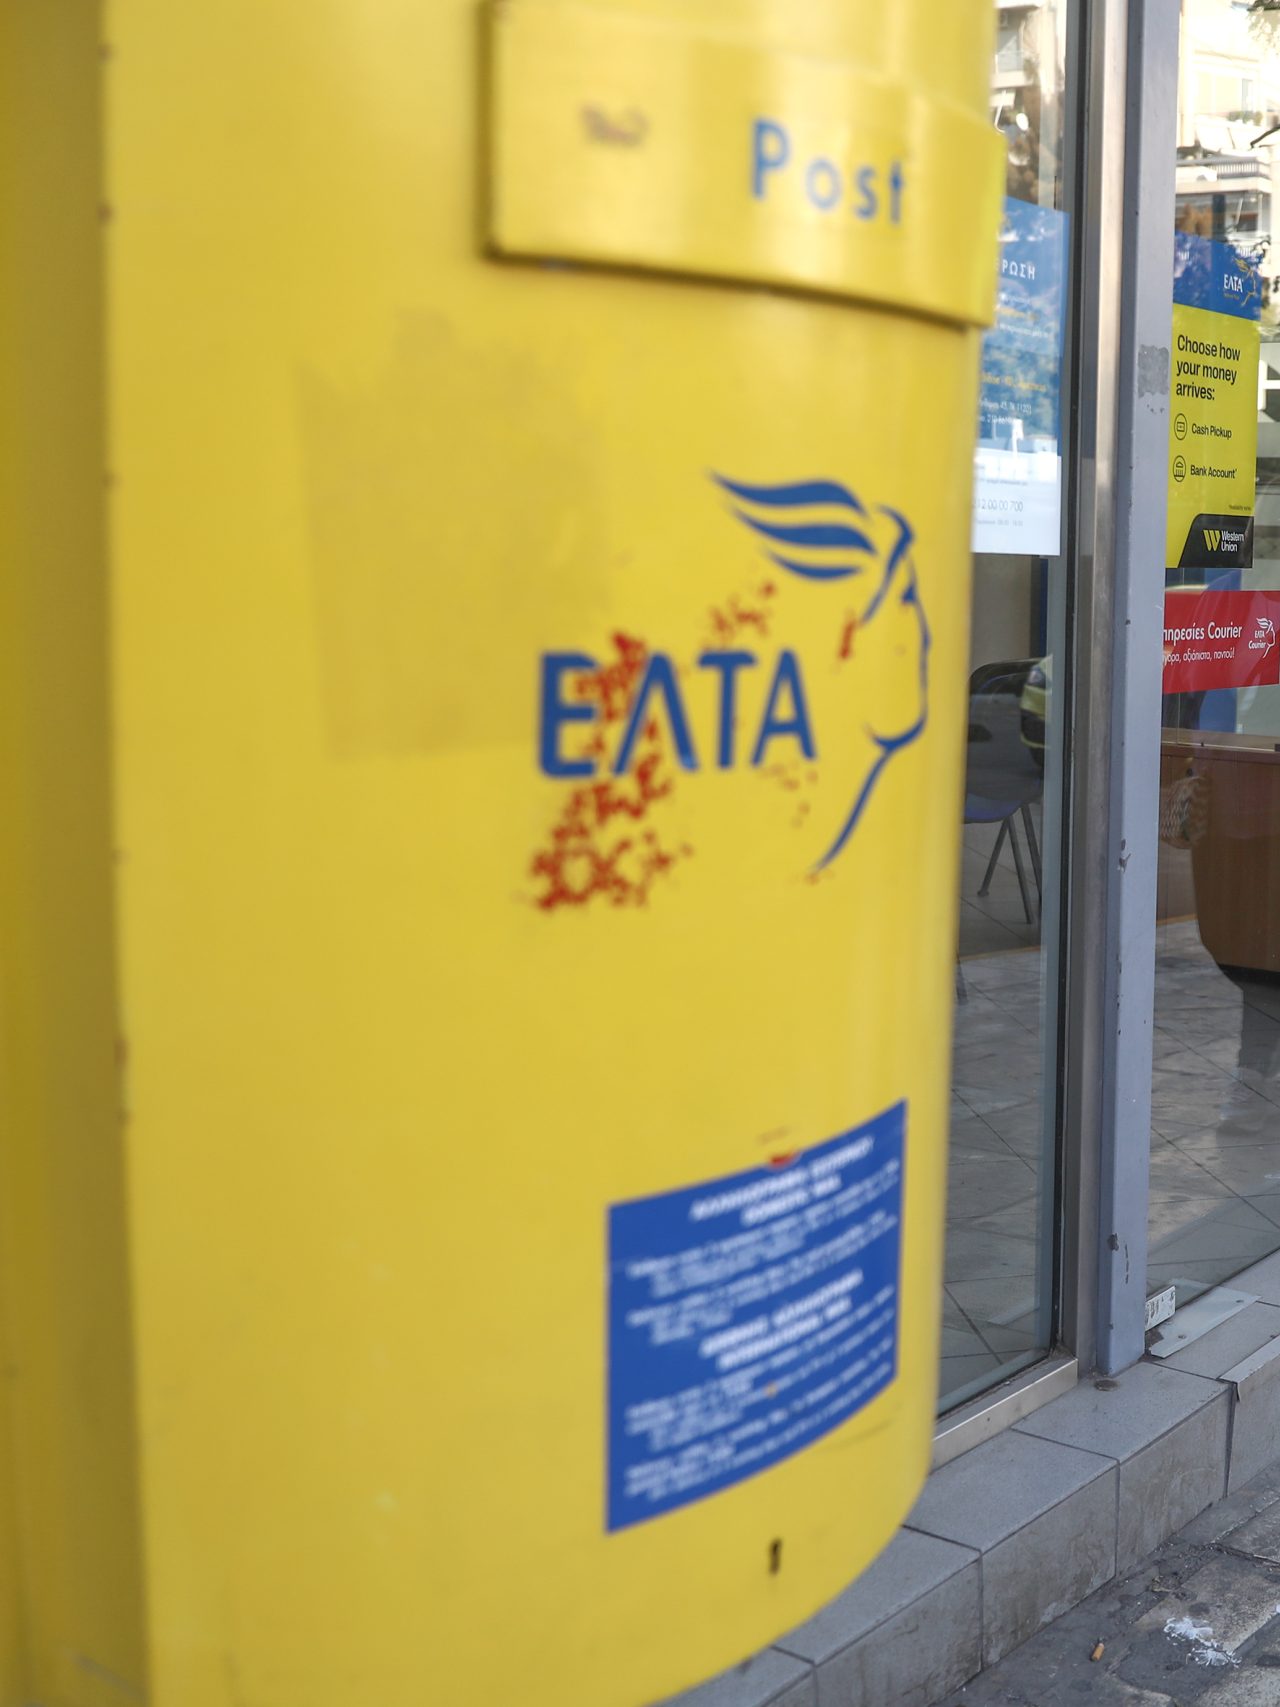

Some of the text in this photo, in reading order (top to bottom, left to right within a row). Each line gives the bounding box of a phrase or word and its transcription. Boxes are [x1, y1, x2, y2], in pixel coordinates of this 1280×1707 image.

[752, 116, 905, 226] Post
[1001, 258, 1036, 280] ΡΩΣΗ
[1223, 273, 1243, 293] ΕΛΤΑ
[1177, 334, 1241, 361] Choose how
[1176, 360, 1237, 386] your money
[1176, 382, 1216, 401] arrives:
[1191, 423, 1233, 440] Cash Pickup
[1190, 464, 1208, 477] Bank
[1221, 530, 1245, 542] Western
[1220, 541, 1238, 552] Union
[1207, 621, 1243, 640] Courier
[1248, 640, 1267, 650] Courier
[539, 648, 817, 779] ΕΛΤΑ
